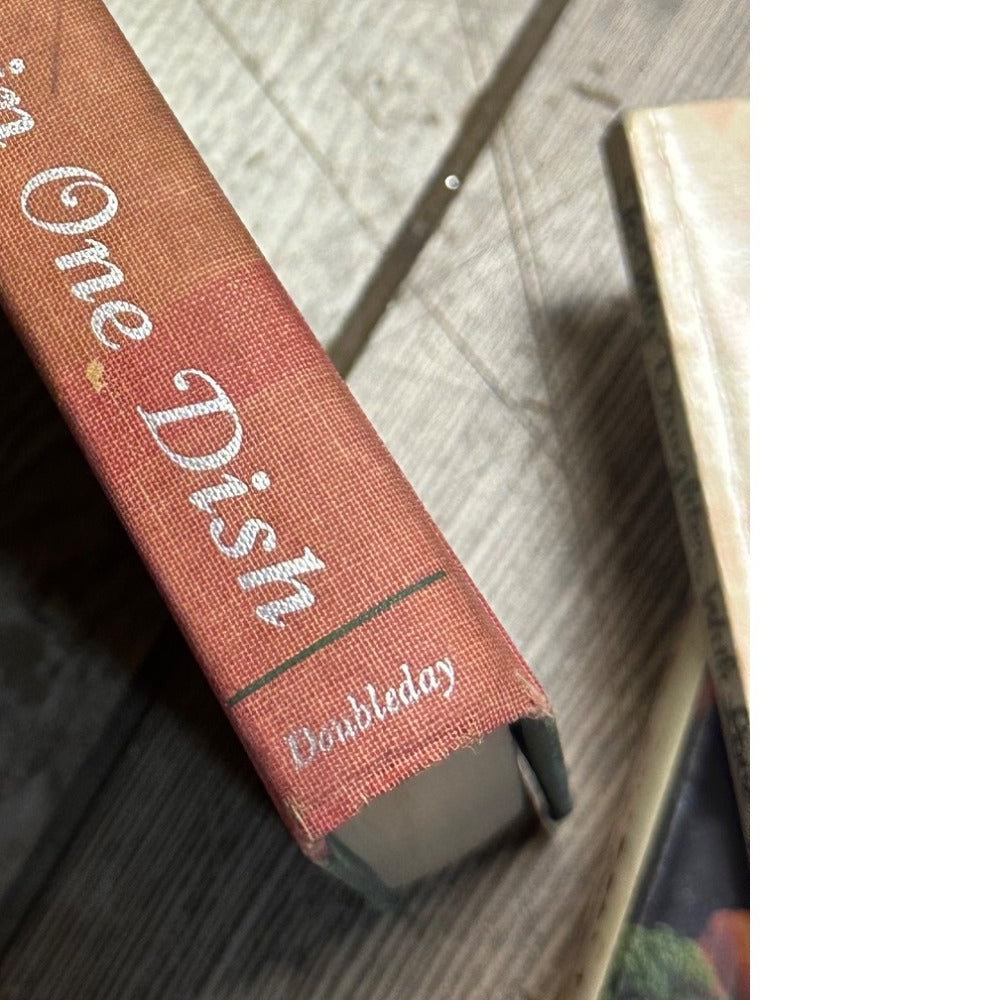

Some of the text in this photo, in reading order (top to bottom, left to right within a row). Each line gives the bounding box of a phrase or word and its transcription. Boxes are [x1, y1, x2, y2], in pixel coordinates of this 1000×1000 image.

[20, 166, 154, 351] One
[136, 367, 327, 630] Dish
[282, 656, 456, 770] Doubleday
